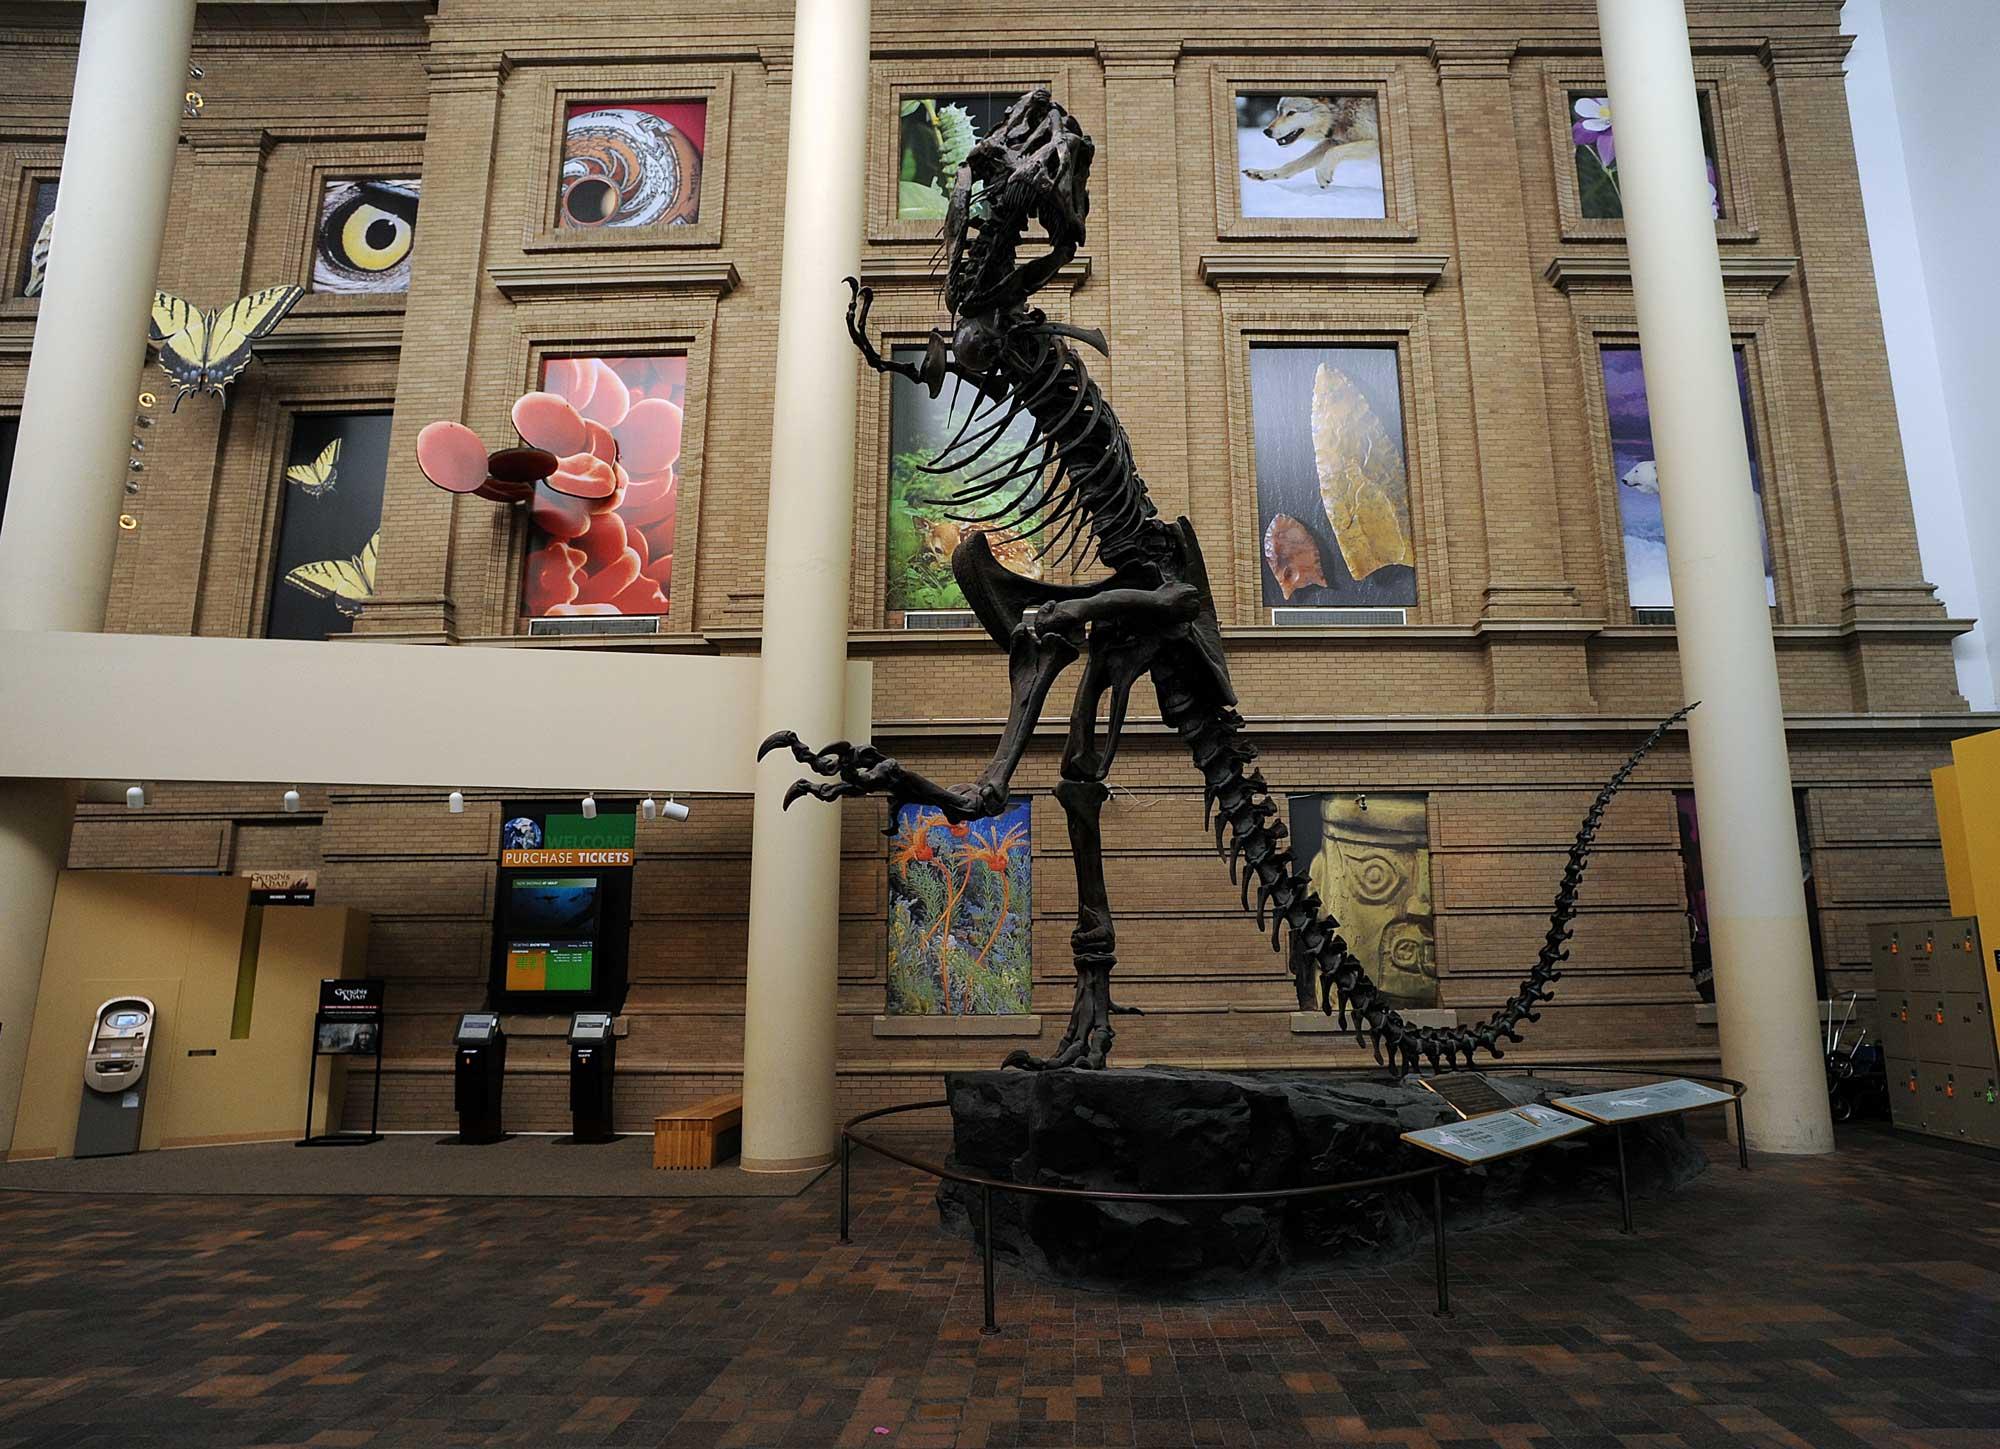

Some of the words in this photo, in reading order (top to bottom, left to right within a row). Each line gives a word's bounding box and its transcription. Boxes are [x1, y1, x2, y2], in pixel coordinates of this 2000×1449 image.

[546, 835, 632, 849] WELCOME
[505, 853, 573, 864] PURCHASE
[578, 852, 630, 863] TICKETS
